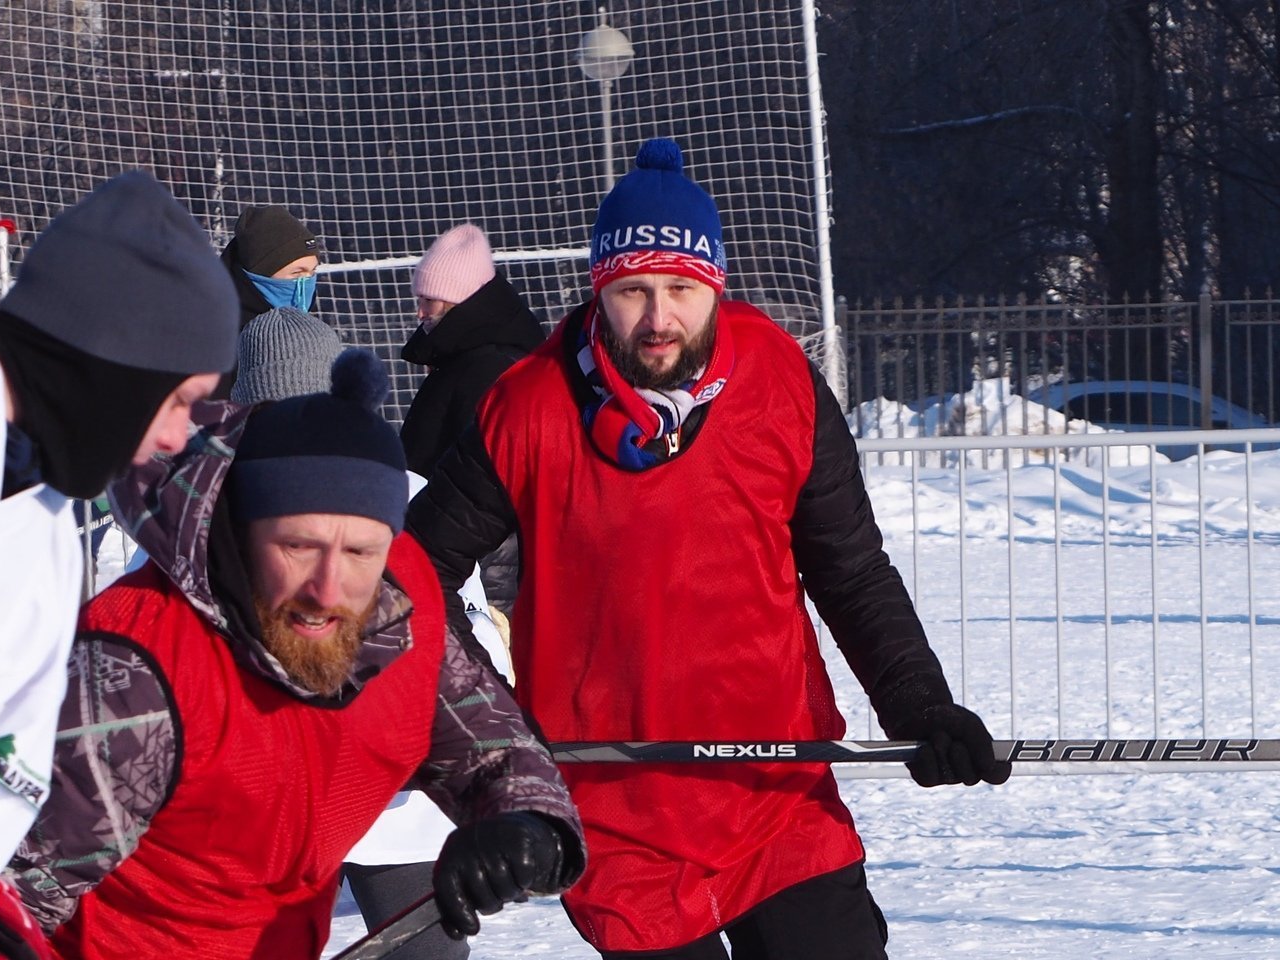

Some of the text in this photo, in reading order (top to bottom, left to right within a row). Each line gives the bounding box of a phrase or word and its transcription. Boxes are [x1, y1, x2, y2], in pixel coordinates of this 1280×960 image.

[600, 225, 712, 258] RUSSIA
[693, 744, 797, 758] NEXUS
[1007, 739, 1259, 761] BAUER
